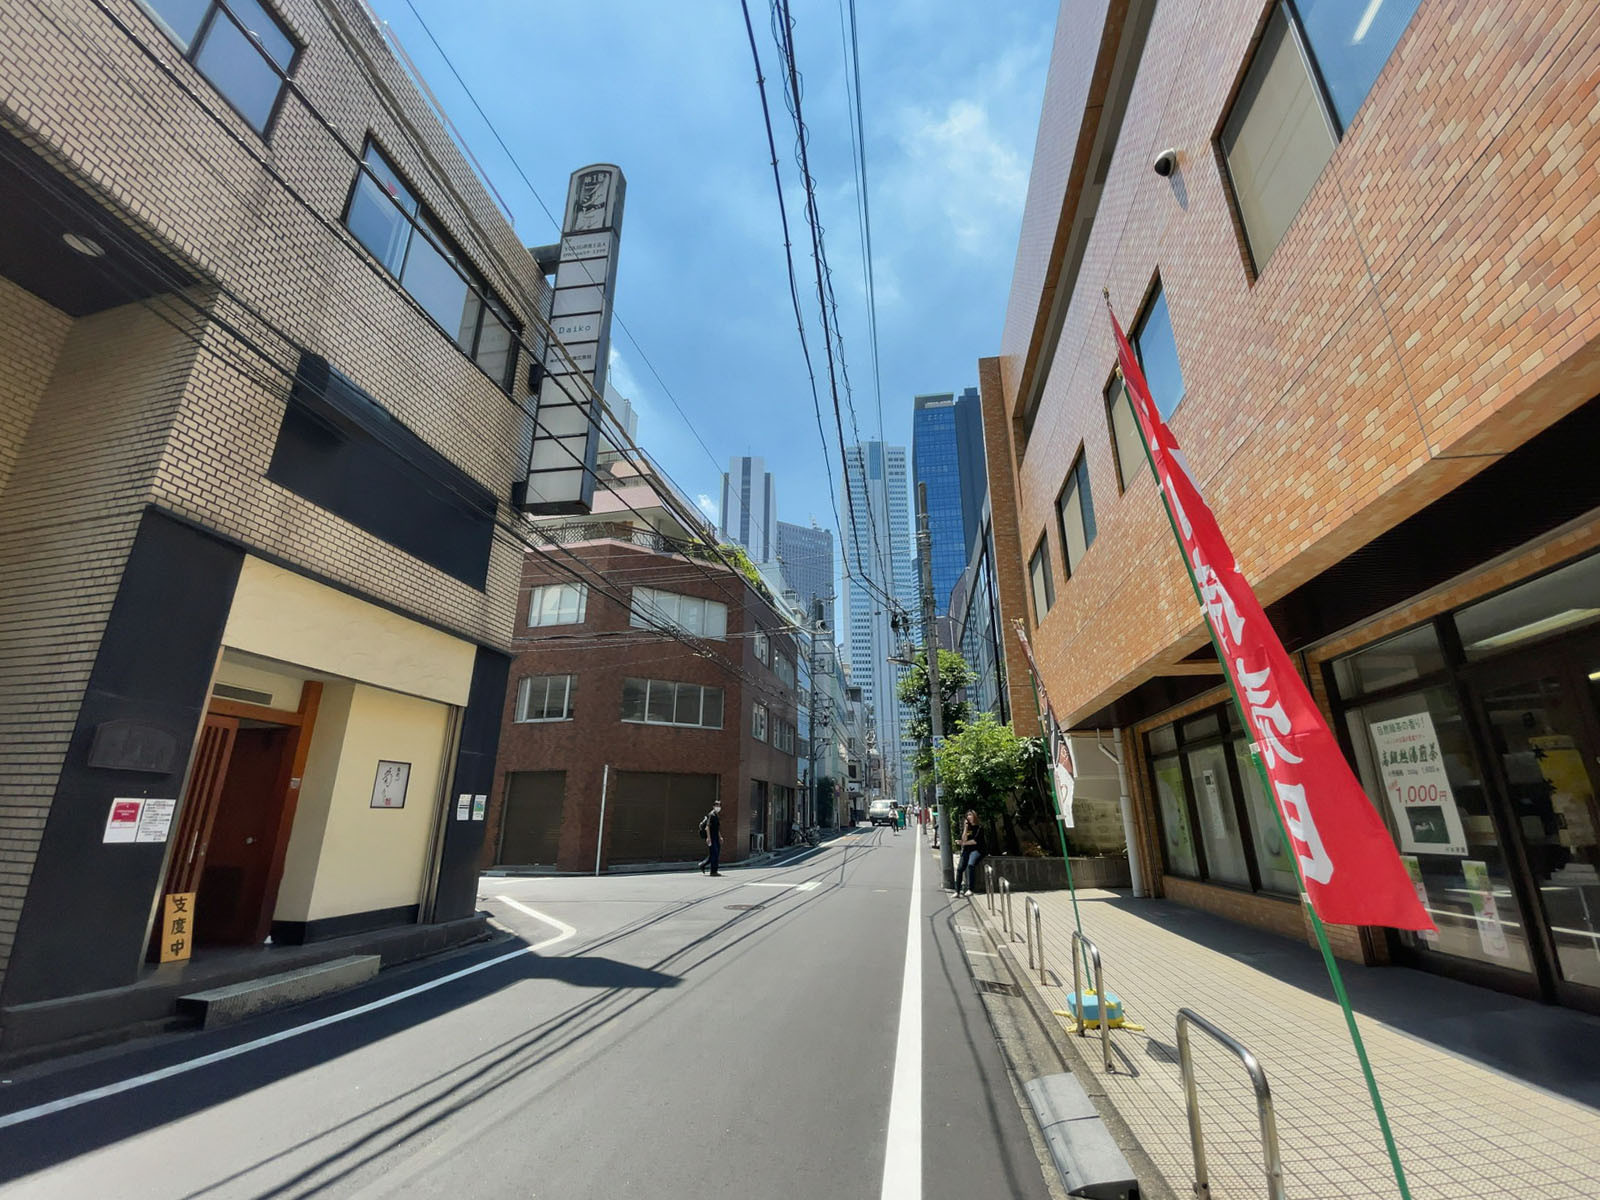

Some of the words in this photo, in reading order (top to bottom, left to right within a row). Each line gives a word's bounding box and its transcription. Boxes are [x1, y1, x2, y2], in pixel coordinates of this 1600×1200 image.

[558, 324, 592, 336] Daiko
[170, 895, 188, 956] 支度中
